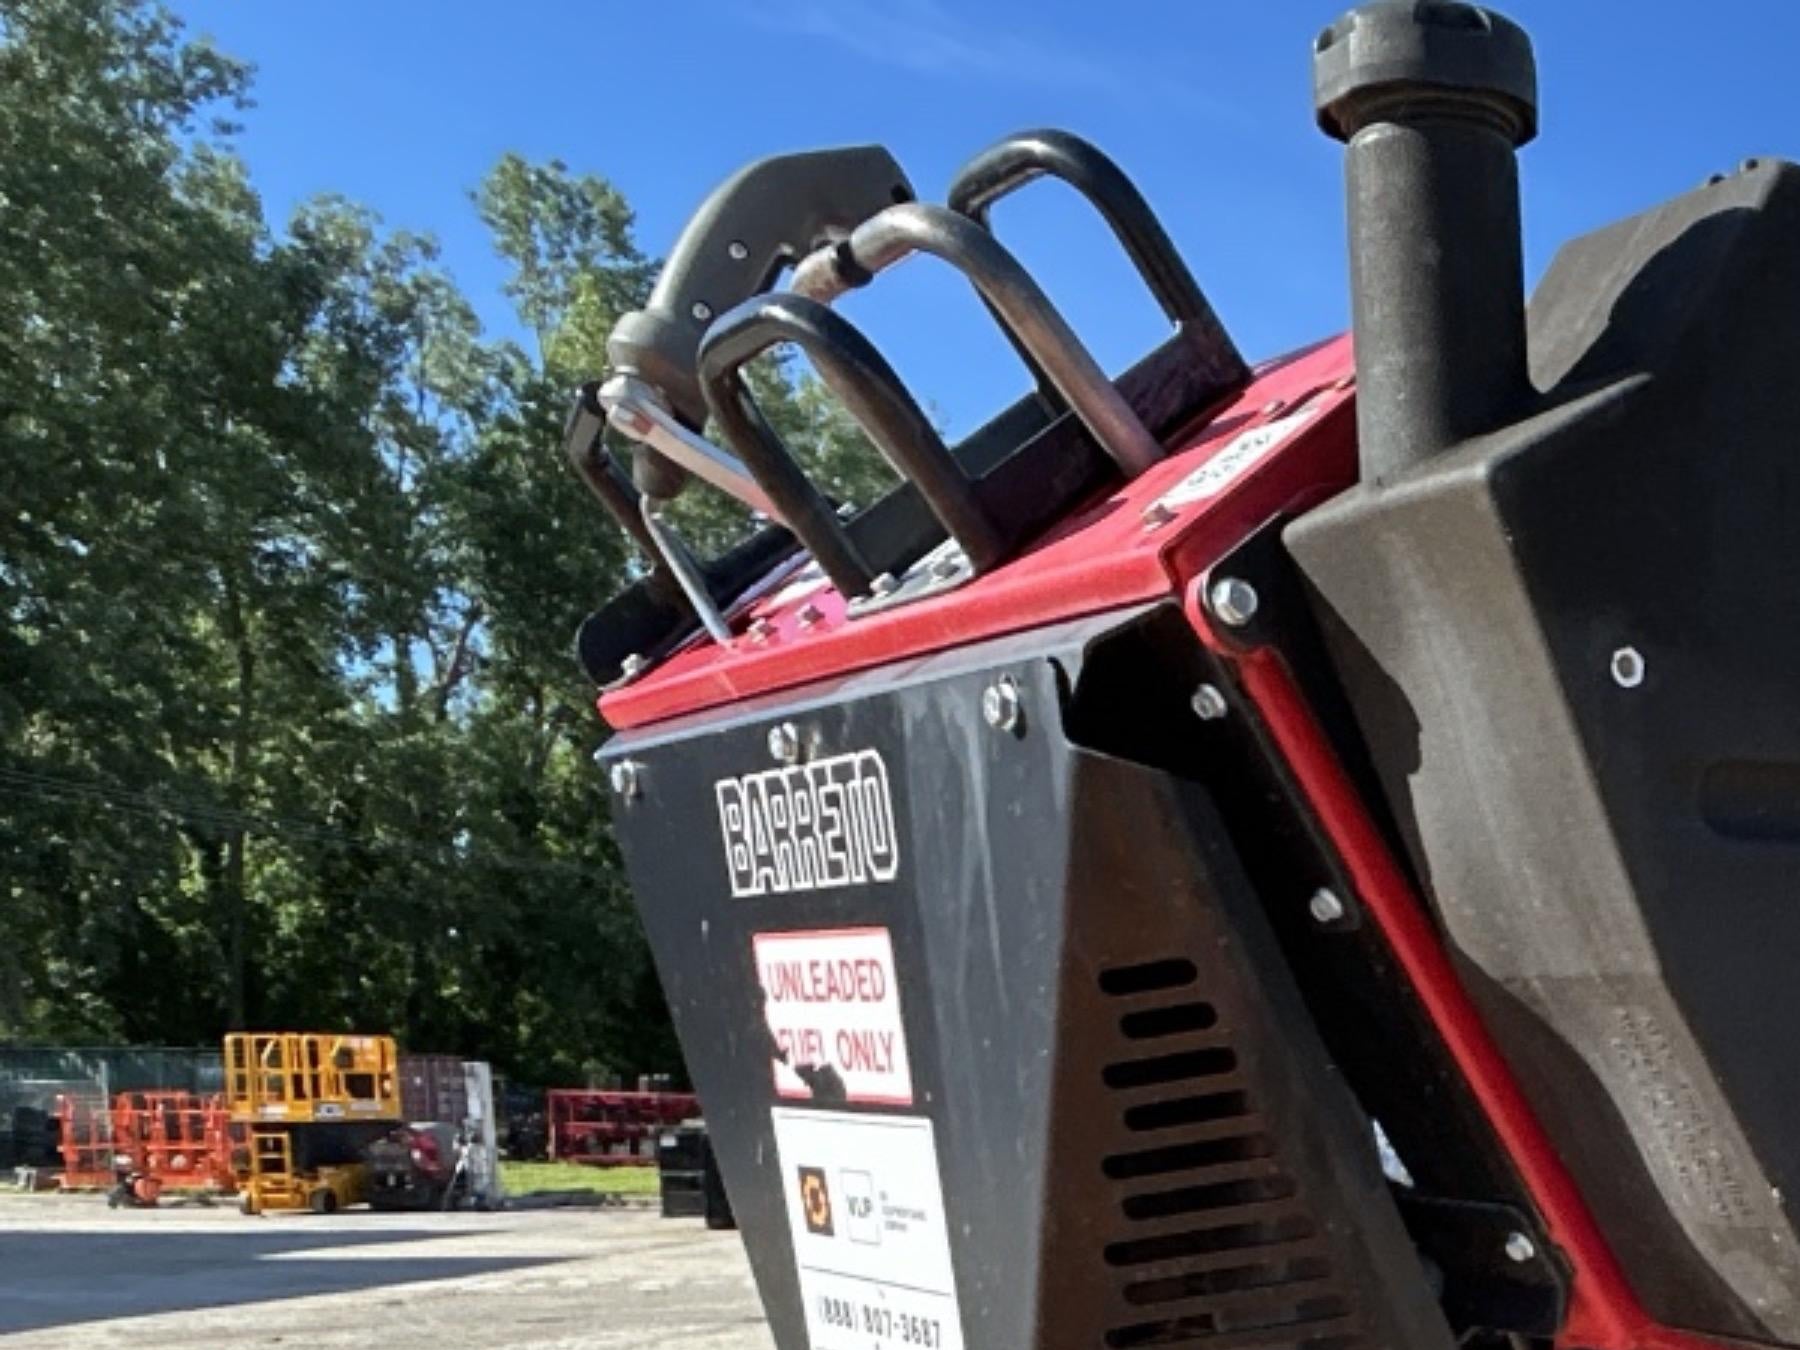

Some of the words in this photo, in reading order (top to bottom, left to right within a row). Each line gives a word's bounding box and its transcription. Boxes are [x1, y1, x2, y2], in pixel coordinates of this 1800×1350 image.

[714, 748, 899, 898] BARRETO
[766, 958, 886, 1003] UNLEADED
[836, 1028, 895, 1074] ONLY
